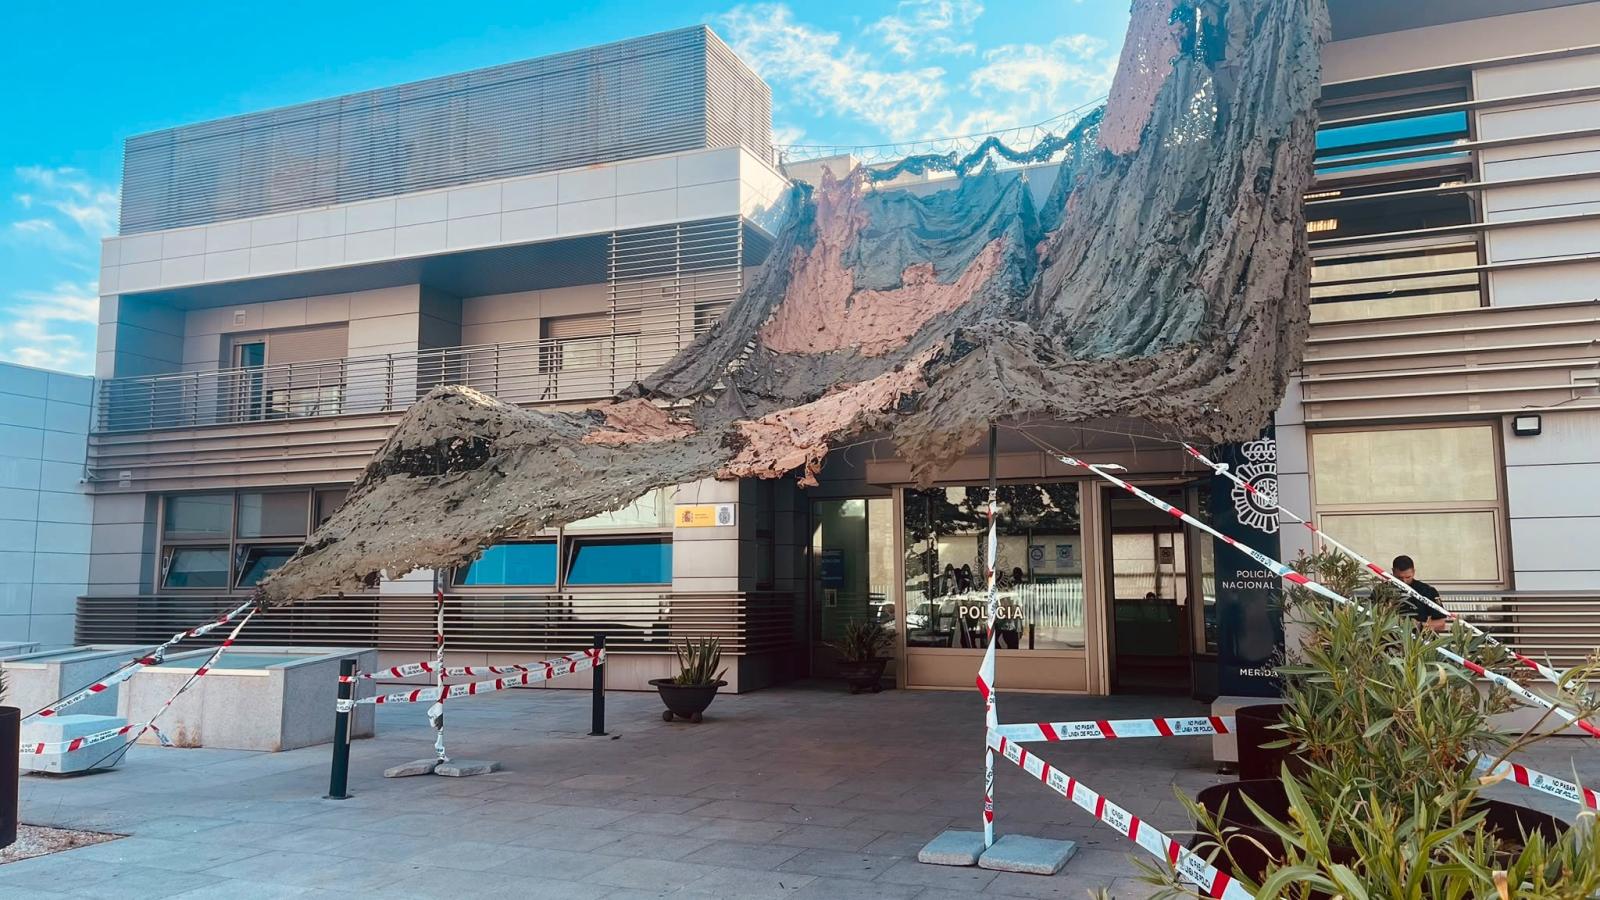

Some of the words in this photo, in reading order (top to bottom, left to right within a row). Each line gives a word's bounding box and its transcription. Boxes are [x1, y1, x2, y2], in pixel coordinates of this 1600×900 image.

[1236, 569, 1274, 578] POLICÍA
[1222, 581, 1274, 589] NACIONAL
[959, 606, 1024, 620] POLCIA
